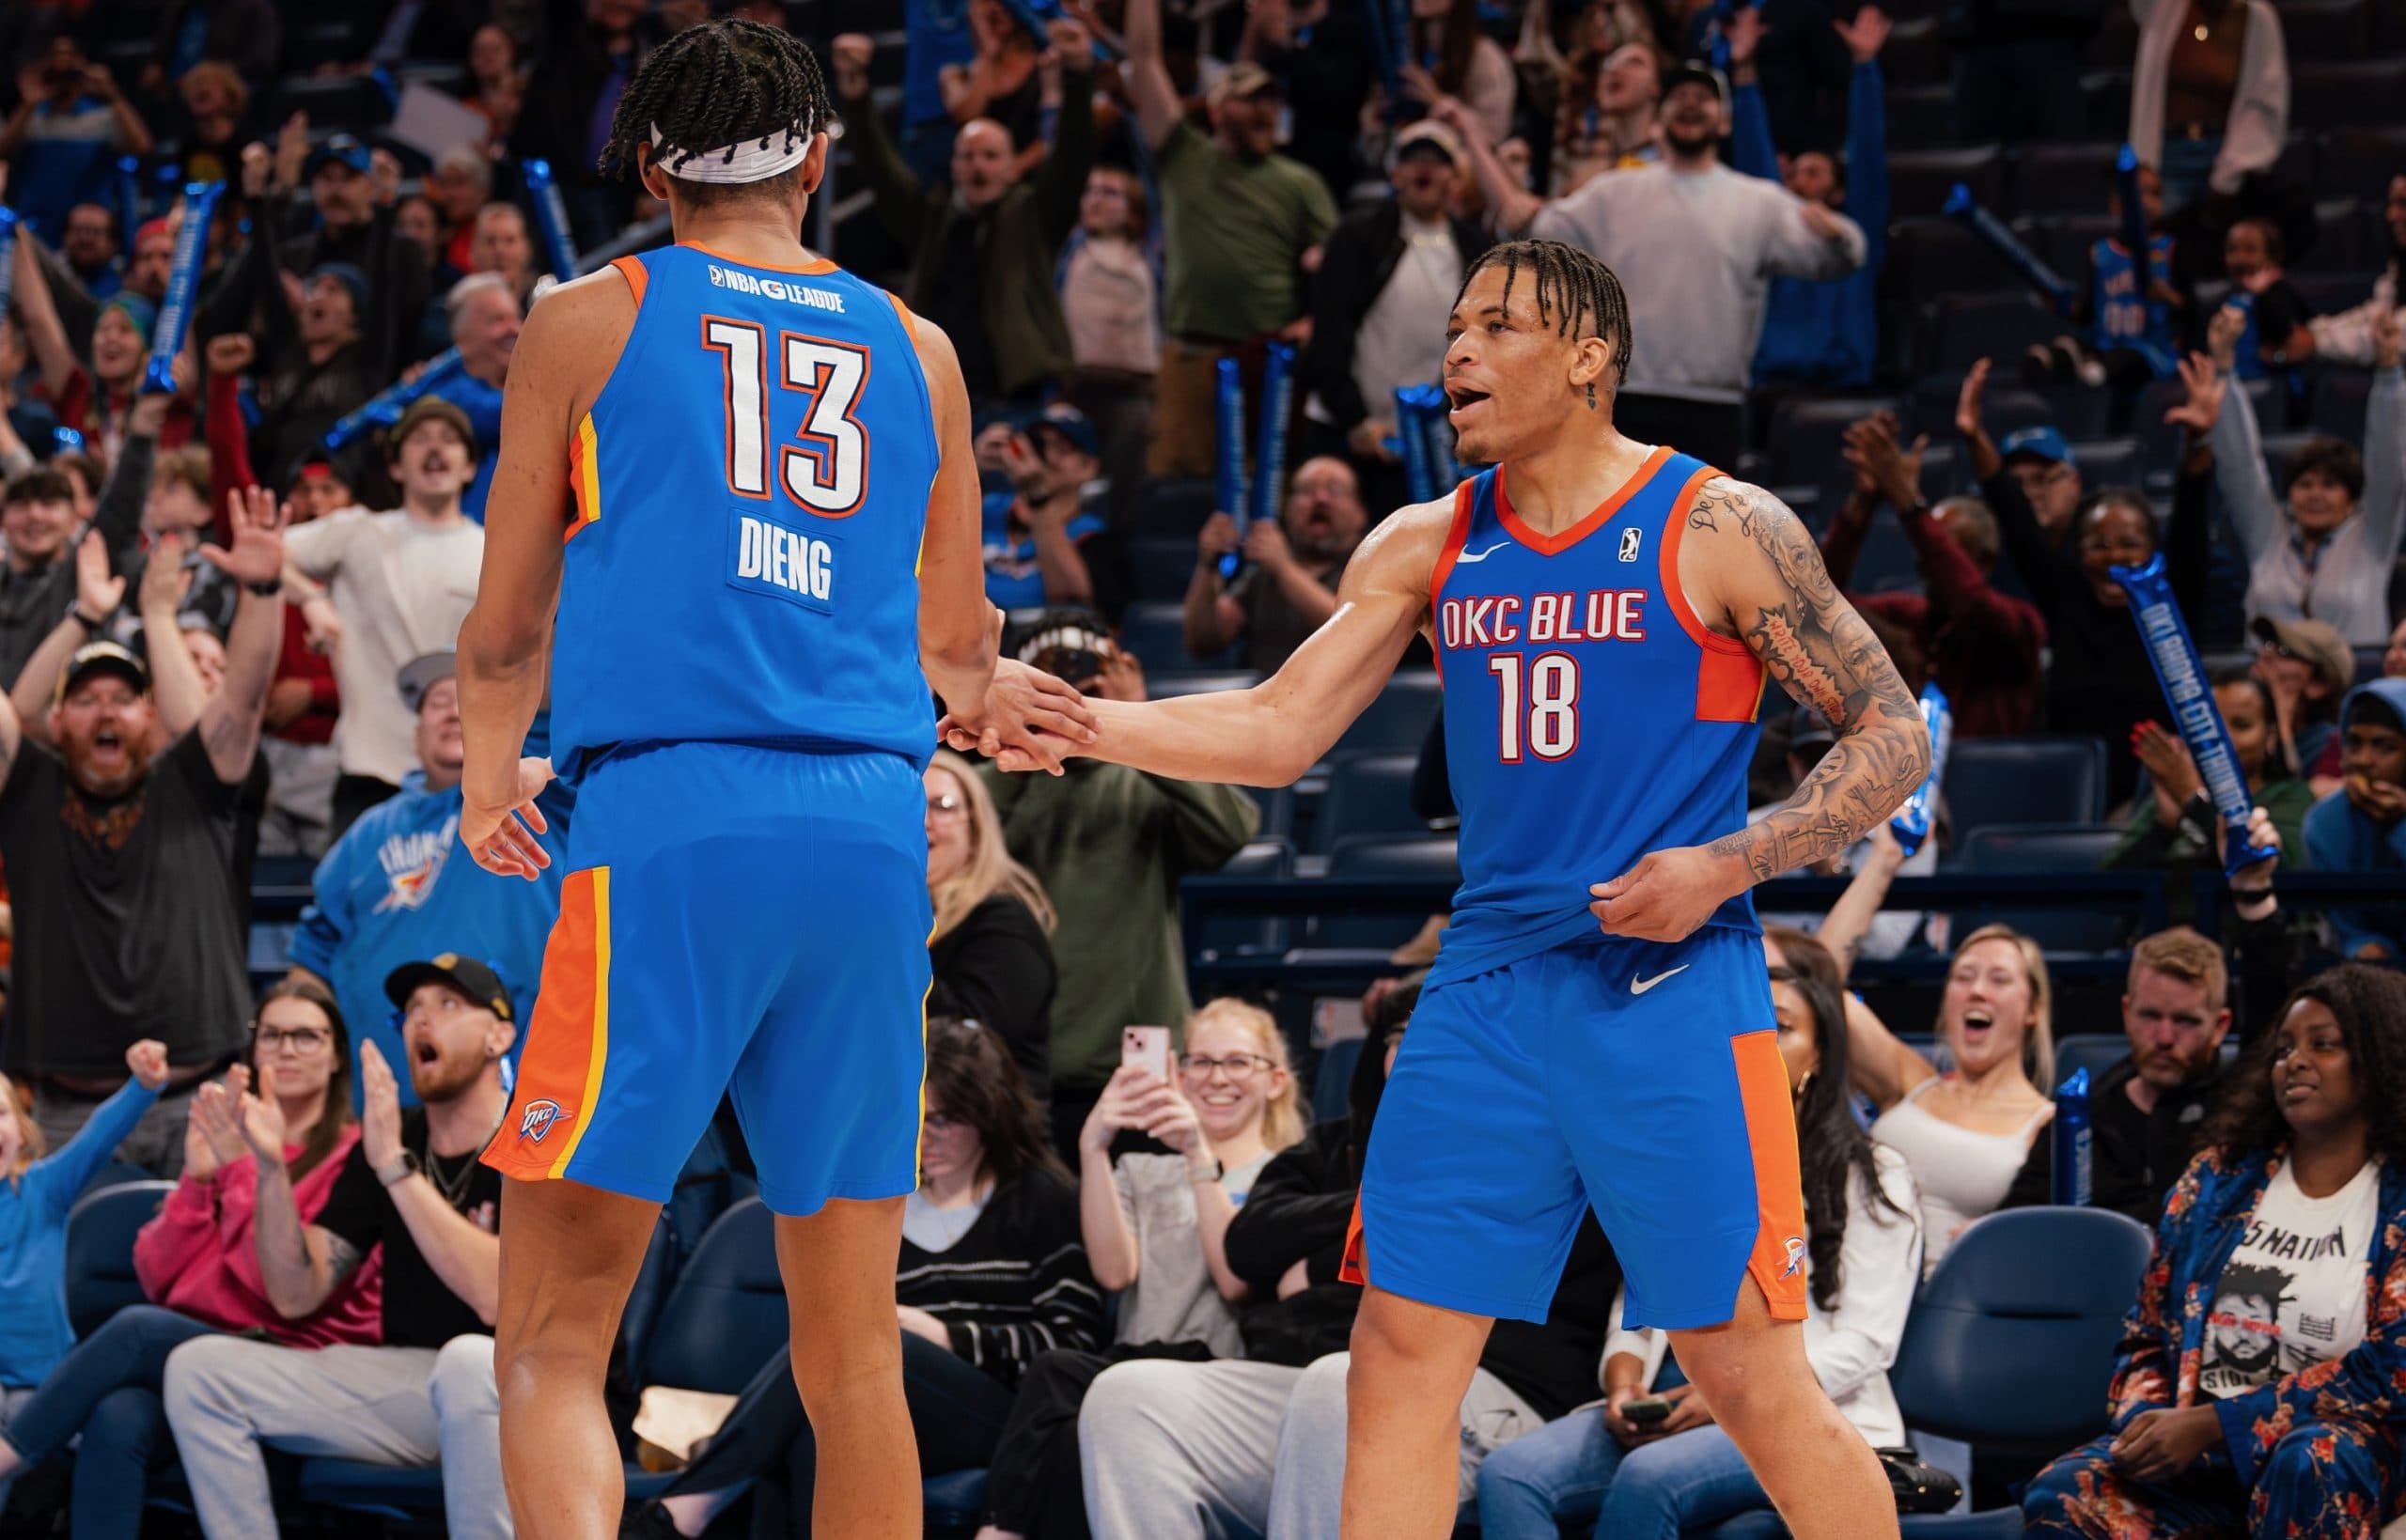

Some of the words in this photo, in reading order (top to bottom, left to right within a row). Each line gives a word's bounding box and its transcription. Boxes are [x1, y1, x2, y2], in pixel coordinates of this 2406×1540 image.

[724, 269, 762, 296] NBA
[785, 283, 846, 314] LEAGUE
[701, 314, 871, 520] 13
[737, 516, 833, 601] DIENG
[1441, 593, 1523, 651] OKC
[1526, 588, 1648, 645] BLUE
[1488, 649, 1582, 765] 18
[2140, 601, 2204, 704] OKLAHOMA
[2179, 700, 2220, 743] CITY
